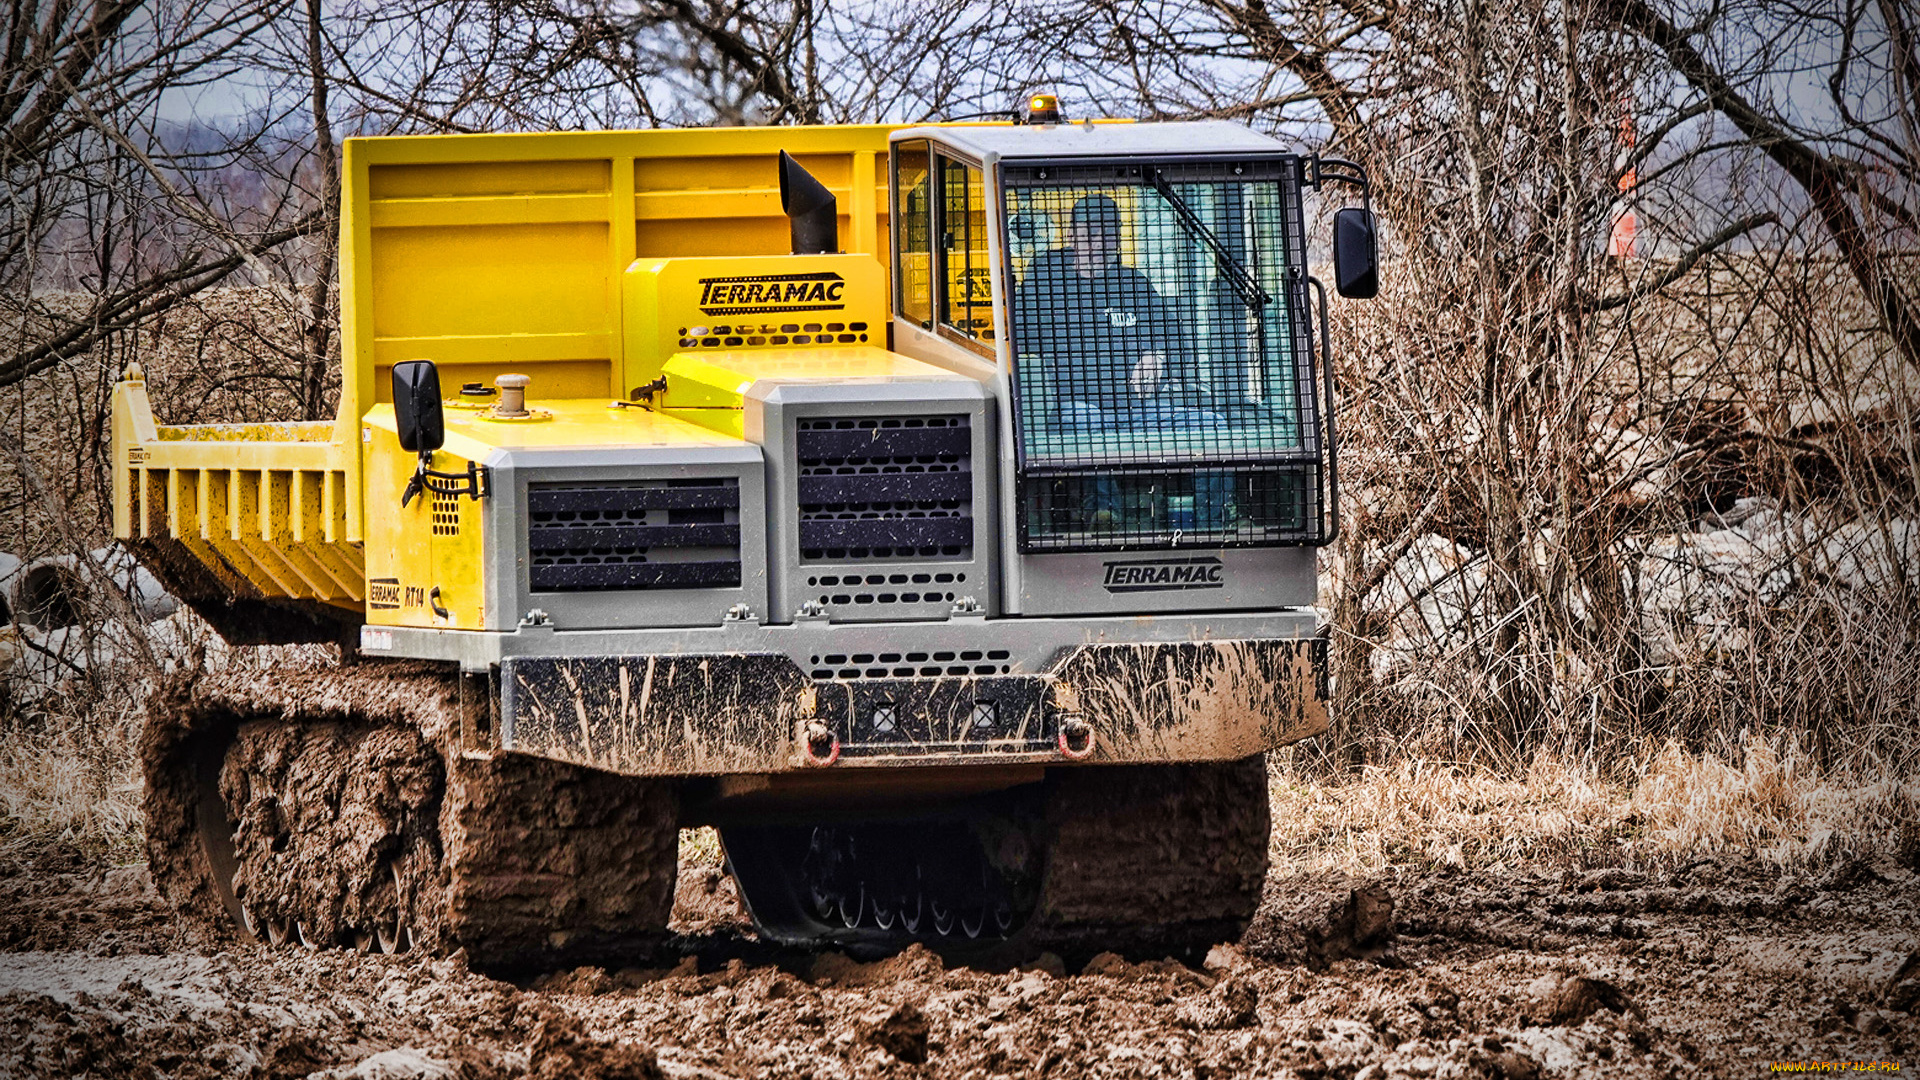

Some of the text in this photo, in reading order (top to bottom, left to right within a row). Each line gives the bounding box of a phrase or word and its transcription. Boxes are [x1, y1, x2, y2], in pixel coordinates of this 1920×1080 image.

[699, 280, 845, 306] TERRAMAC
[1103, 563, 1223, 585] TERRAMAC
[405, 586, 424, 608] RT14
